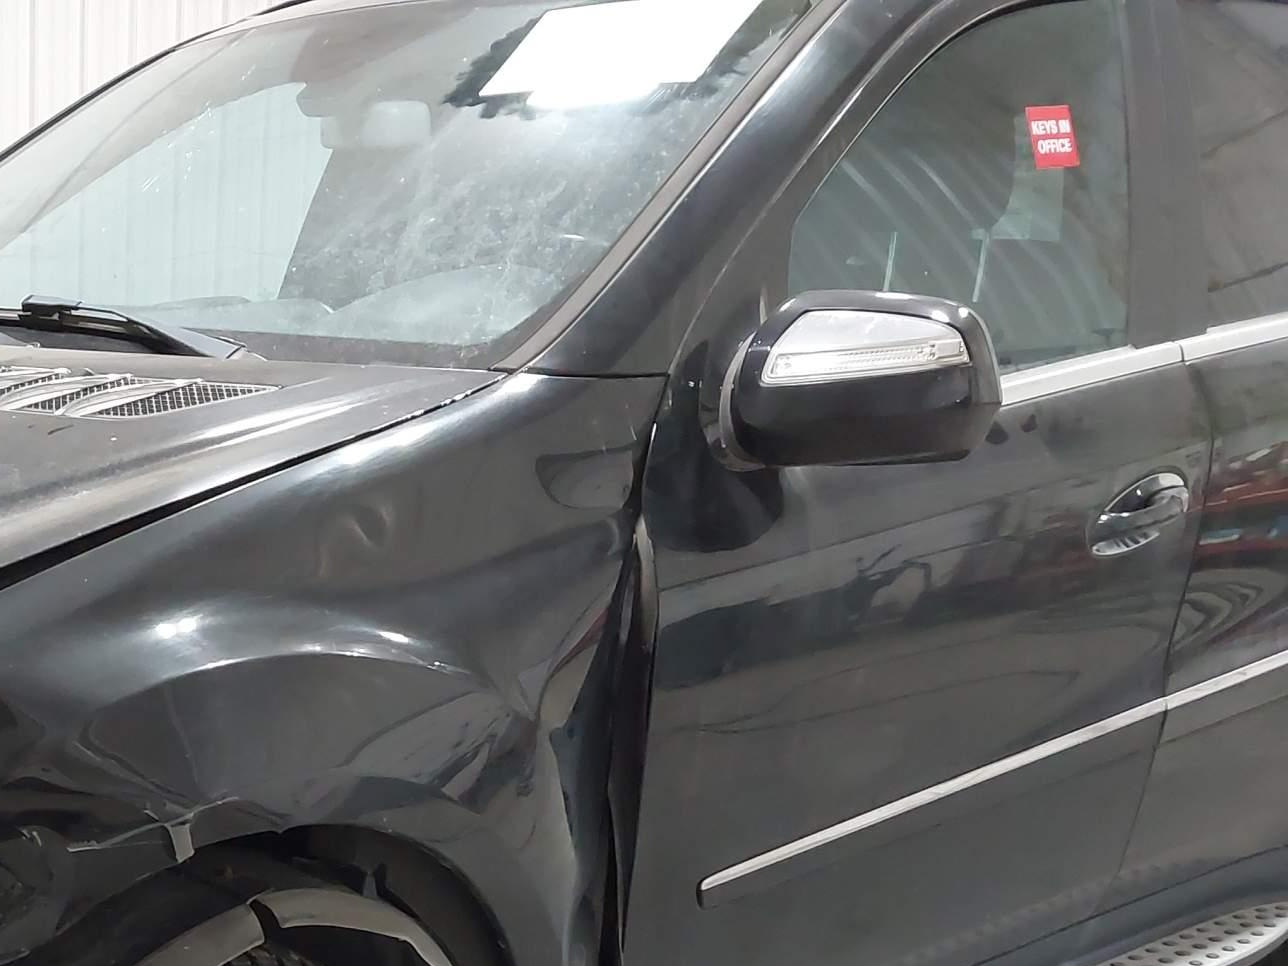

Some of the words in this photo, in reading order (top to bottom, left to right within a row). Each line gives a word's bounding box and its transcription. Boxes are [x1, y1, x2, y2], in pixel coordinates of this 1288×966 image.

[1031, 120, 1058, 135] KEYS
[1058, 119, 1071, 134] IN
[1037, 138, 1073, 154] OFFICE
